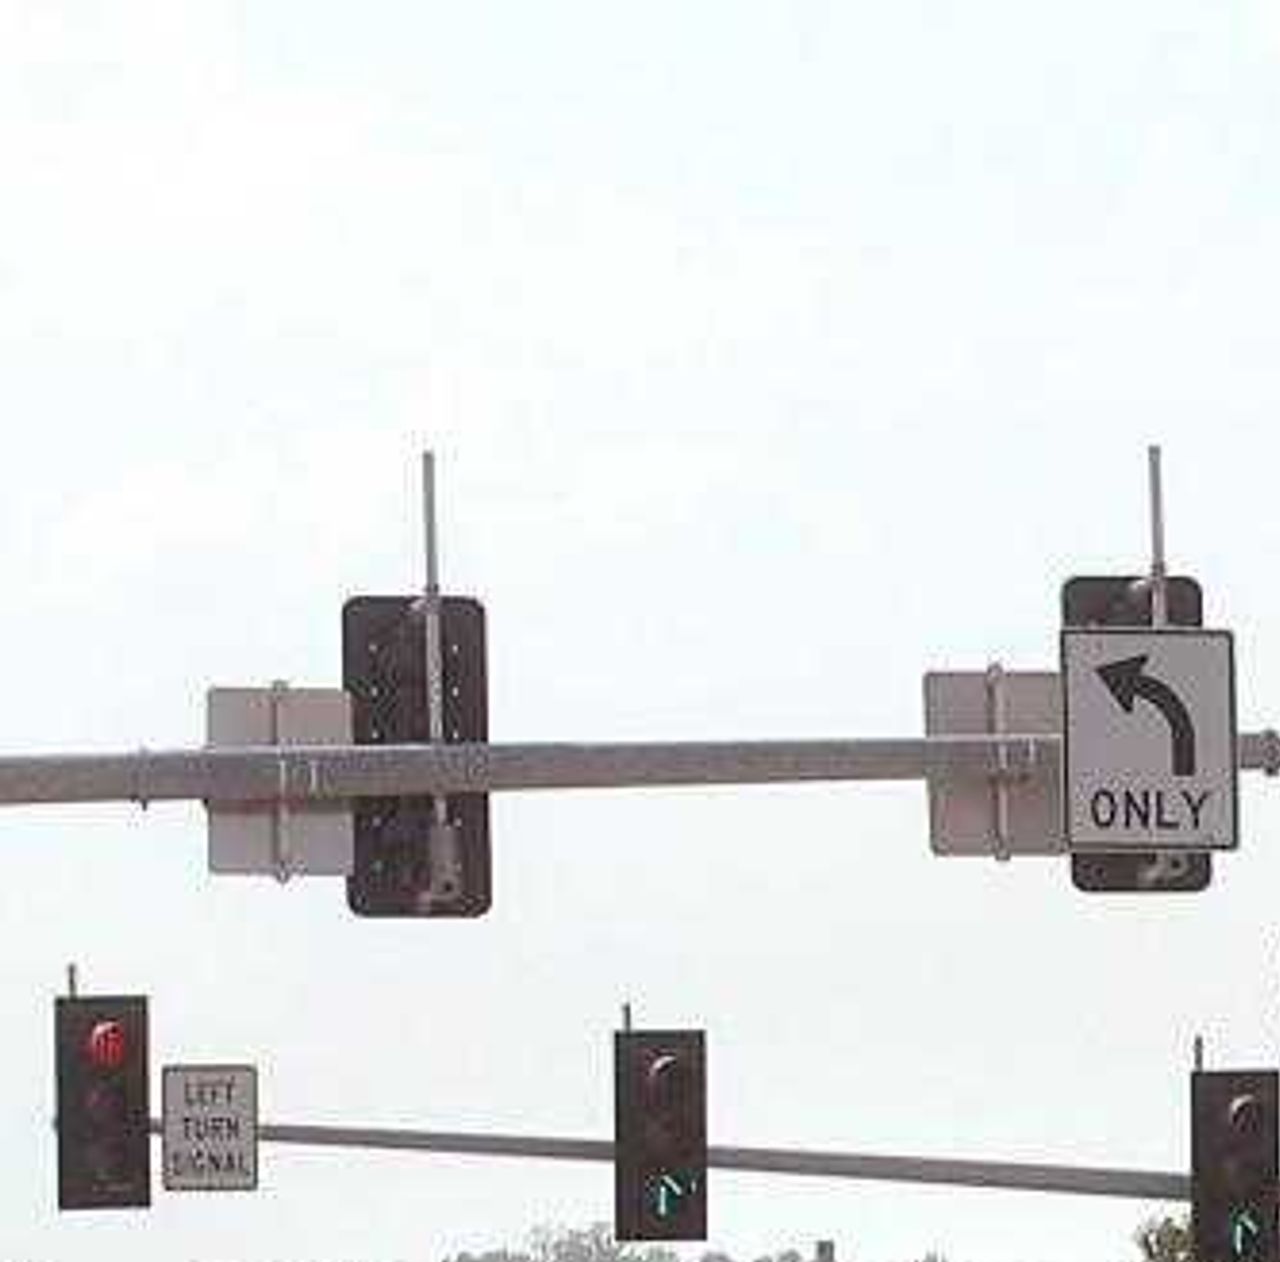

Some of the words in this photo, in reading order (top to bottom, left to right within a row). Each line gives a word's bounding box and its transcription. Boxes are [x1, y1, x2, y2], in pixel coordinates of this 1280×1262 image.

[1090, 789, 1212, 830] ONLY
[184, 1075, 236, 1105] LEFT
[183, 1116, 240, 1141] TURN
